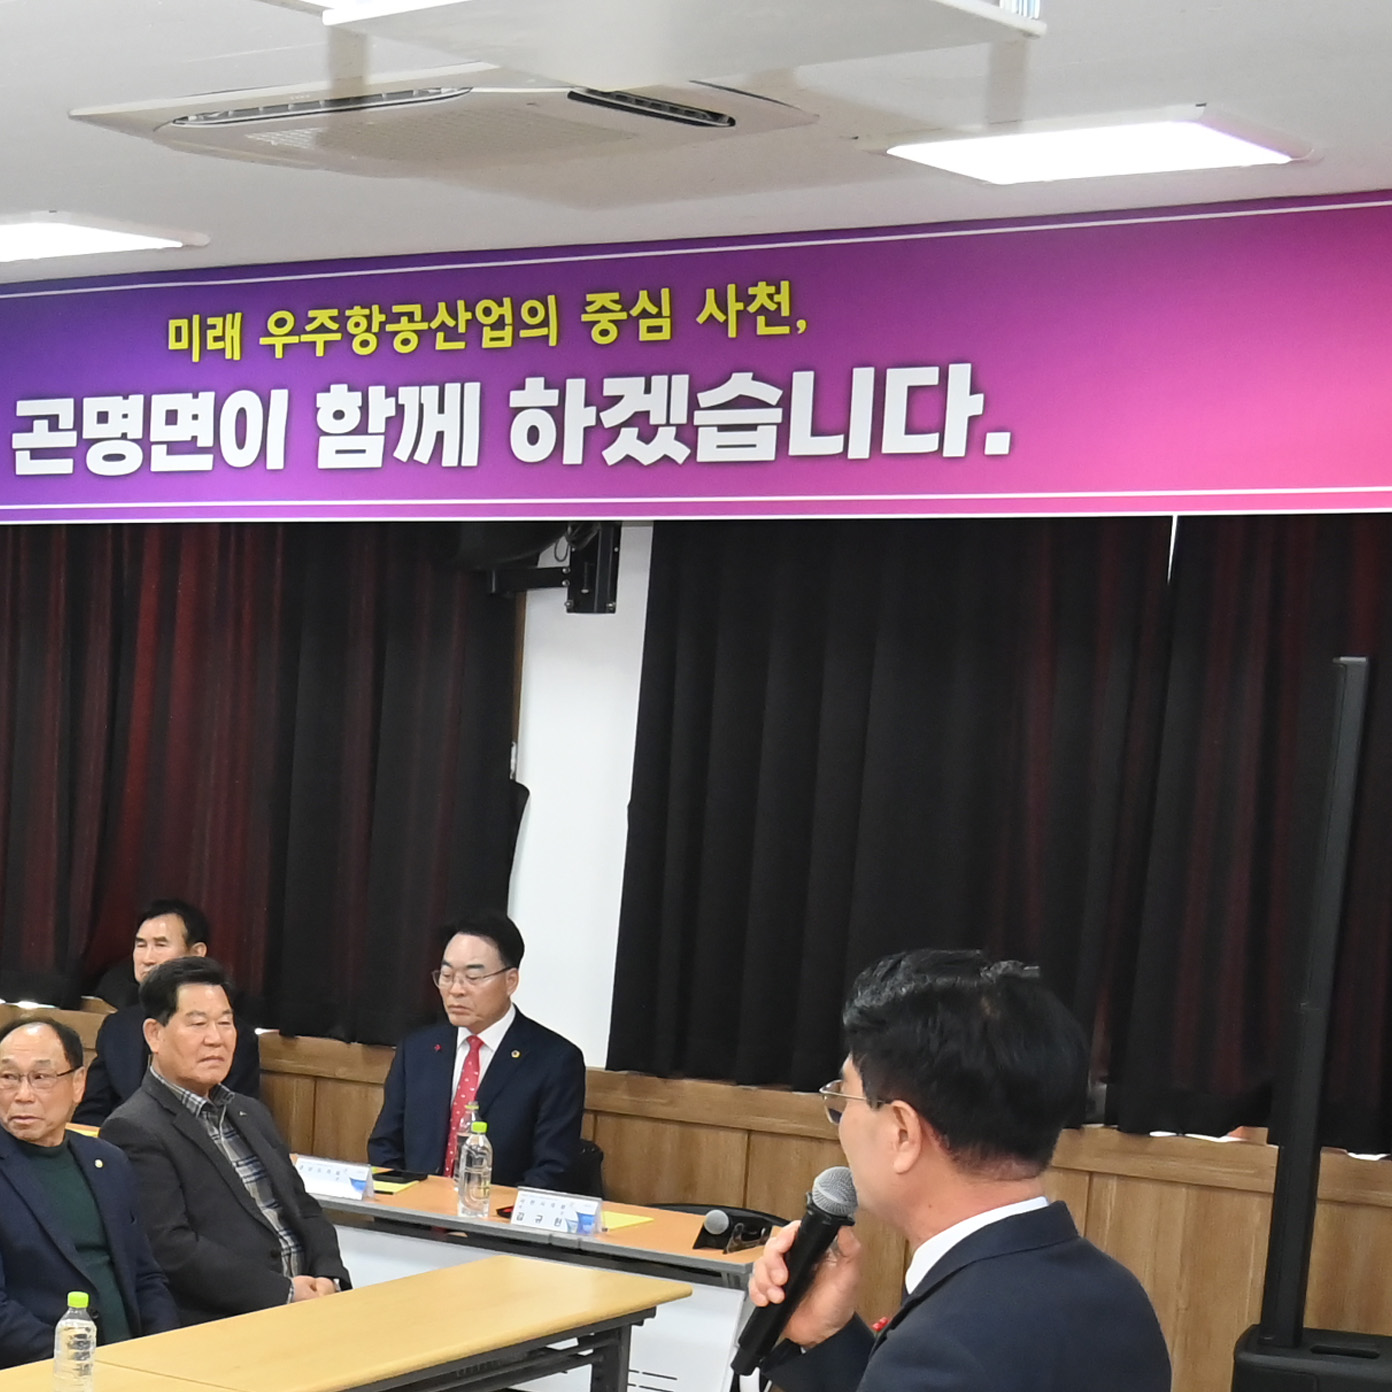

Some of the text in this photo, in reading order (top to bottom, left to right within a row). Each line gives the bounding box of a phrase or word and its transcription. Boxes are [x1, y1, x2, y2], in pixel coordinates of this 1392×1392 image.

[168, 279, 808, 362] 미래 우주항공산업의 중심 사천,
[12, 362, 1012, 477] 곤명면이 함께 하겠습니다.
